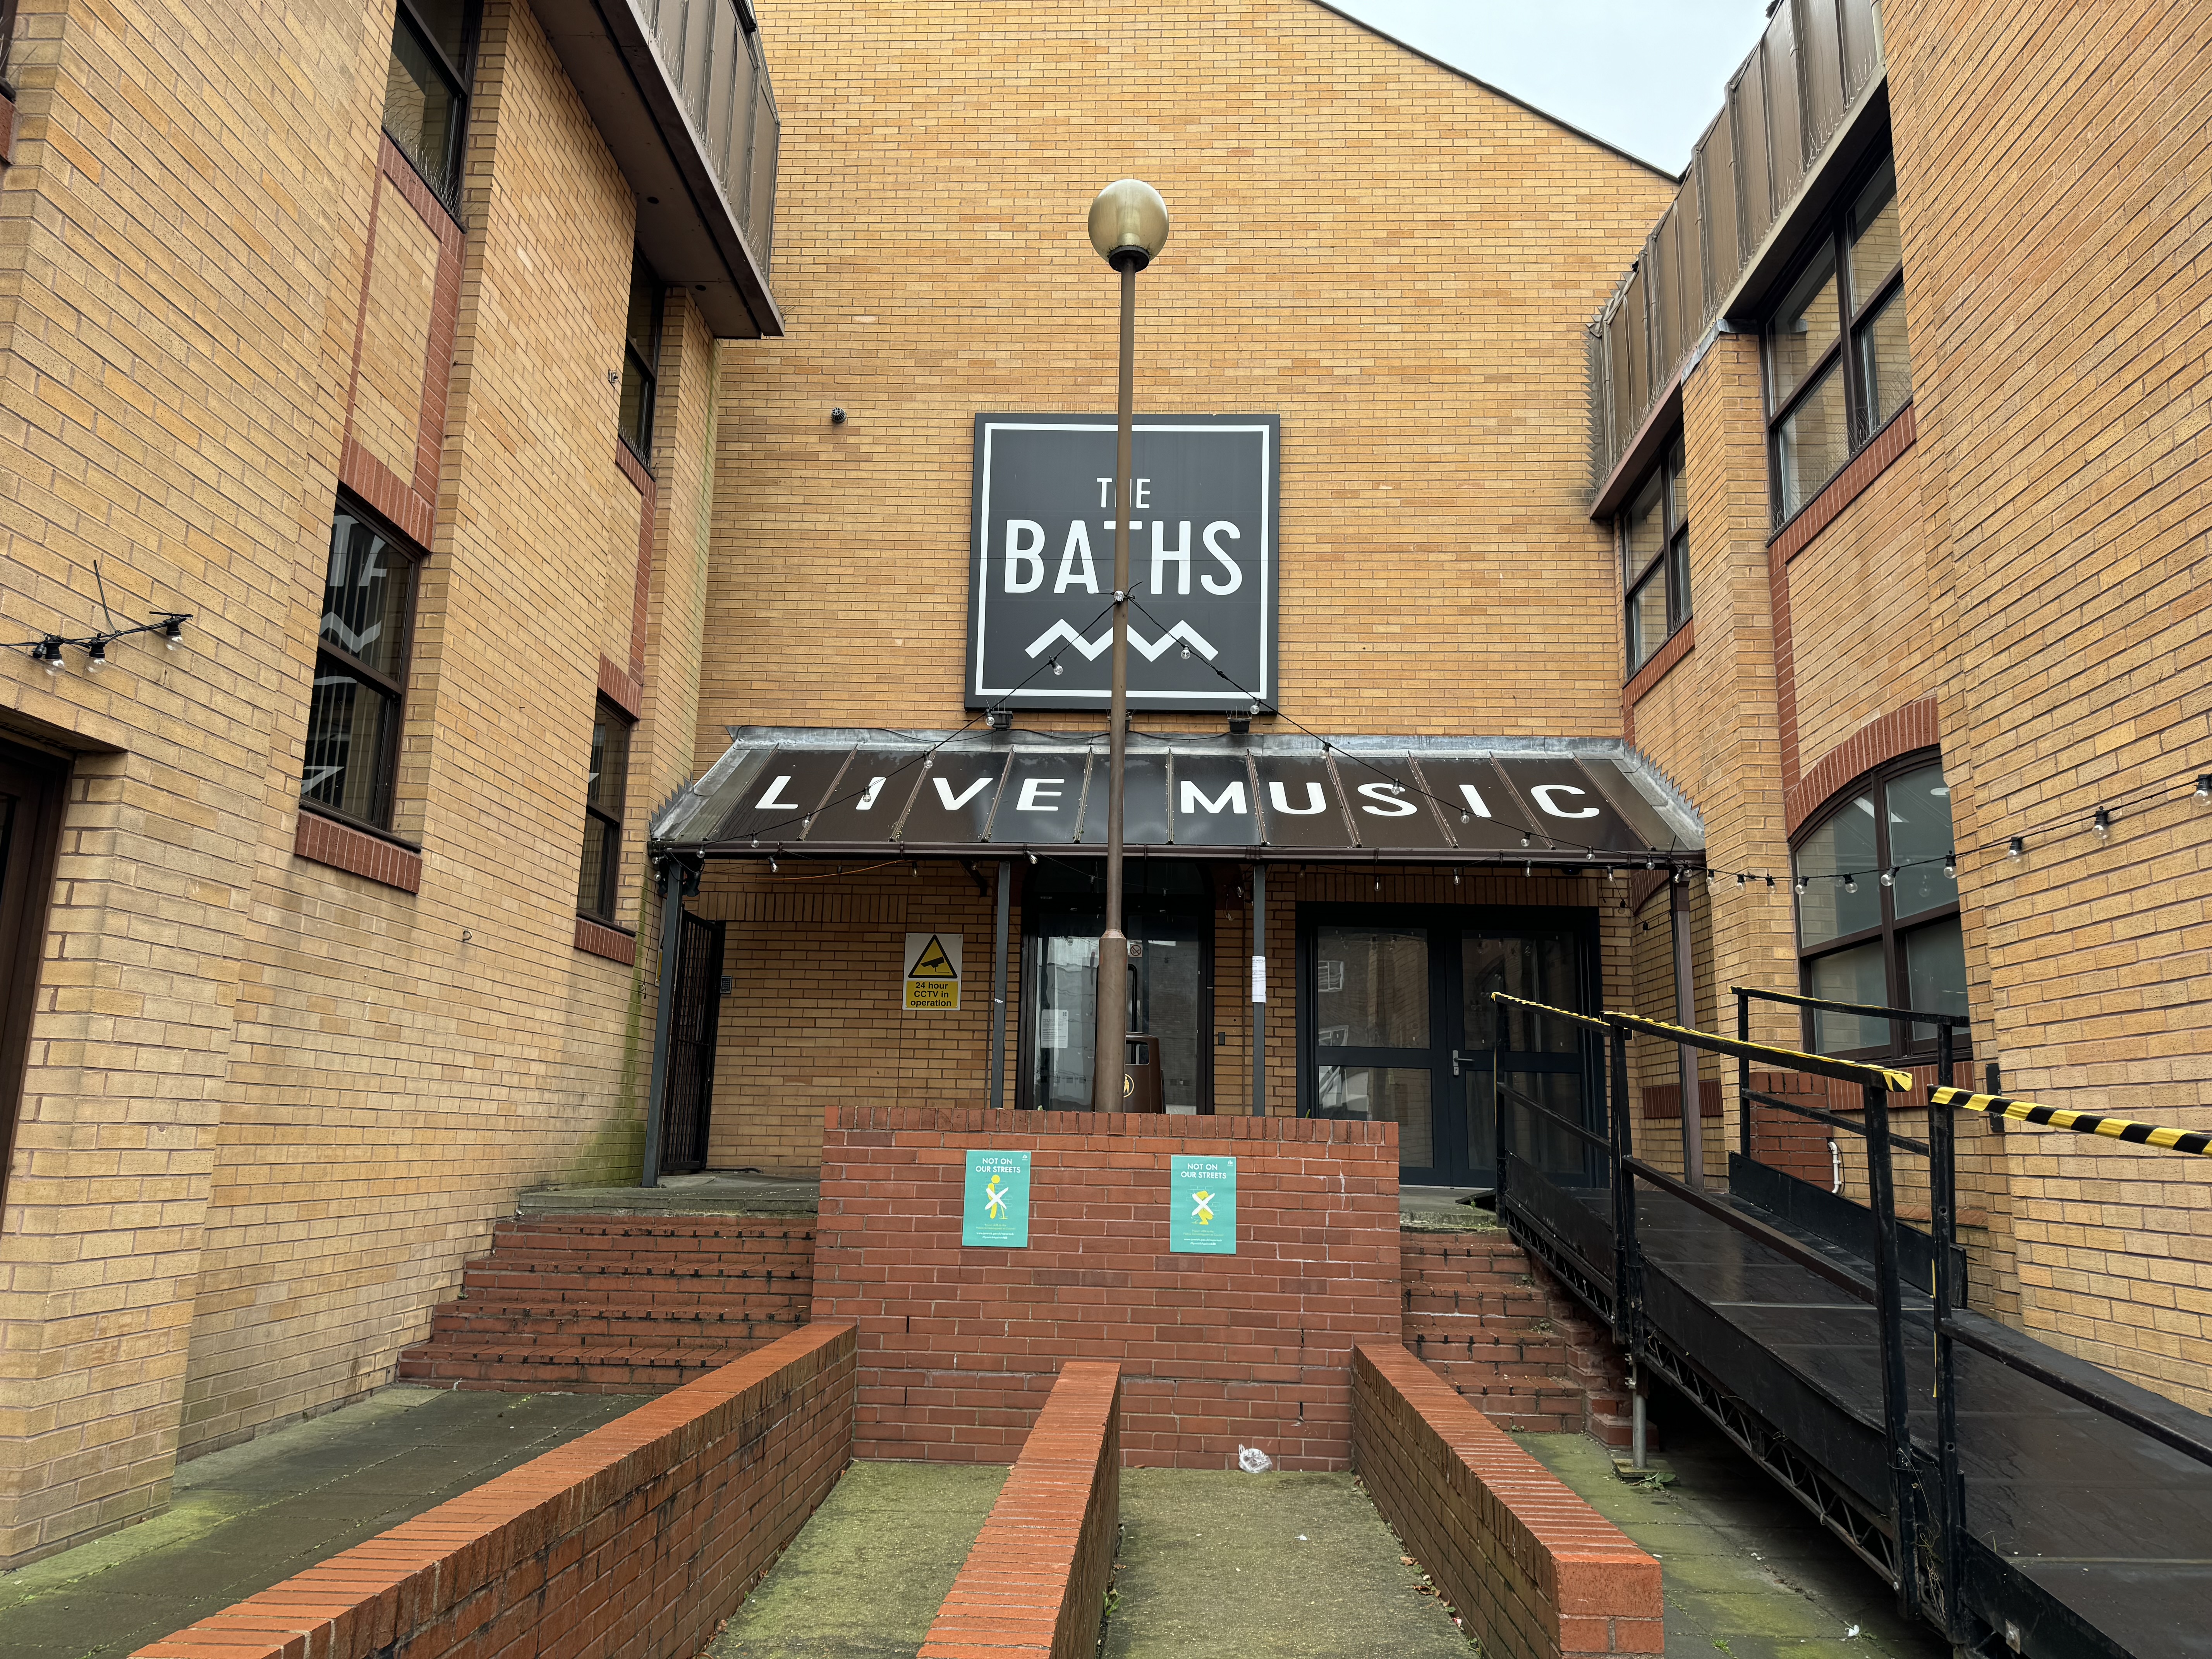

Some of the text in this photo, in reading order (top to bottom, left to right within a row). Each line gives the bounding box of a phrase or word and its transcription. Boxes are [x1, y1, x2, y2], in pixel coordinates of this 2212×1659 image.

[1096, 478, 1151, 508] TE
[1004, 519, 1243, 596] BAHS
[754, 776, 1600, 819] LIVE MUSIC
[910, 1000, 951, 1008] operation
